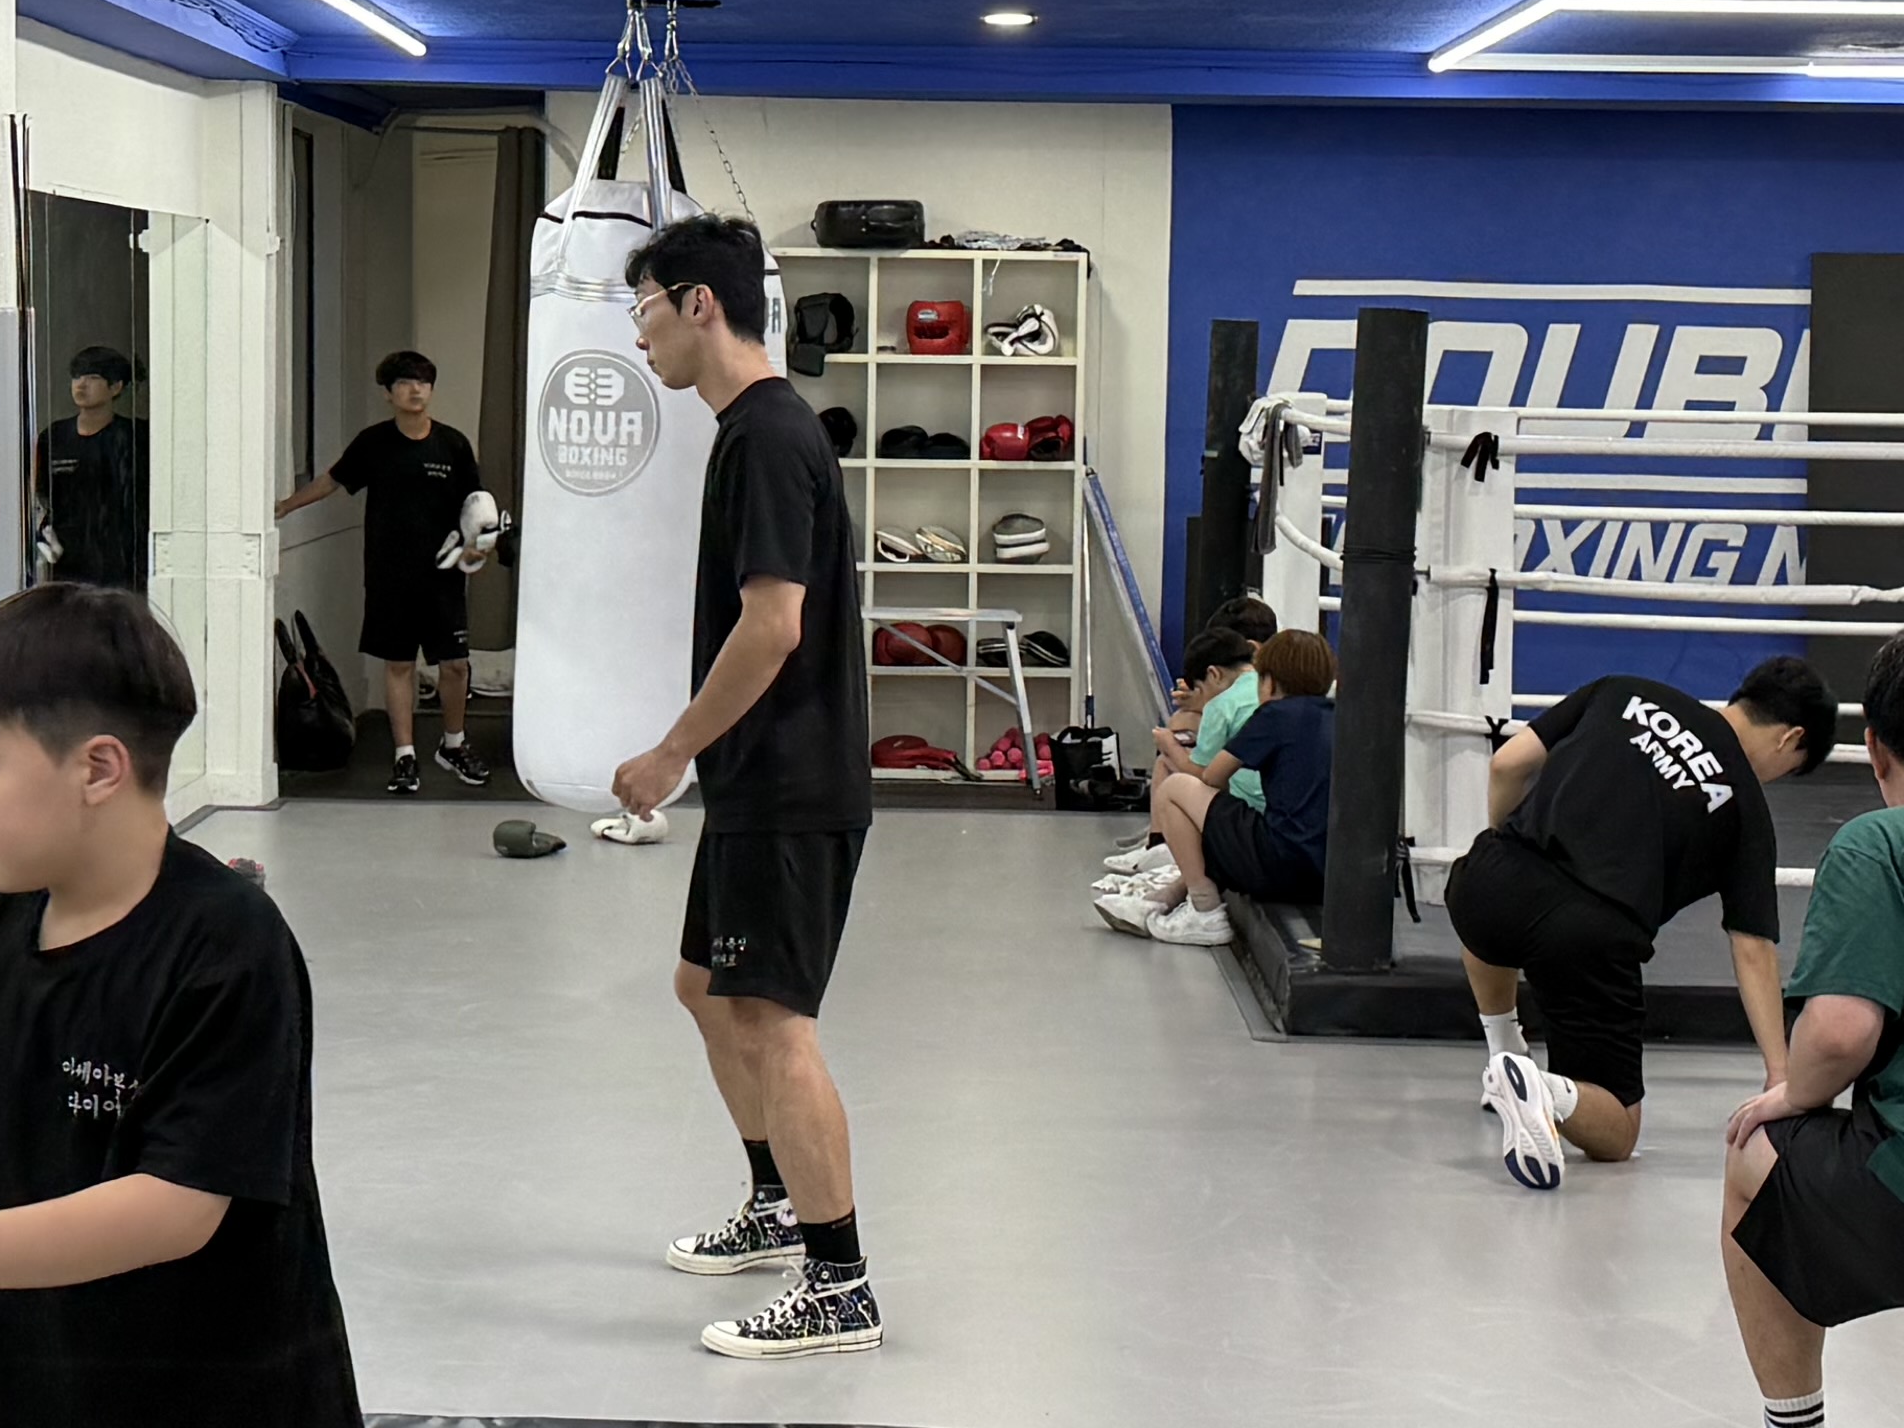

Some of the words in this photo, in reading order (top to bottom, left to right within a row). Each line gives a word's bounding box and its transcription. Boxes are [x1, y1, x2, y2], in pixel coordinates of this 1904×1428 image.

[557, 444, 628, 466] BOXING
[1622, 696, 1733, 814] KOREA
[1629, 731, 1695, 790] ARMY
